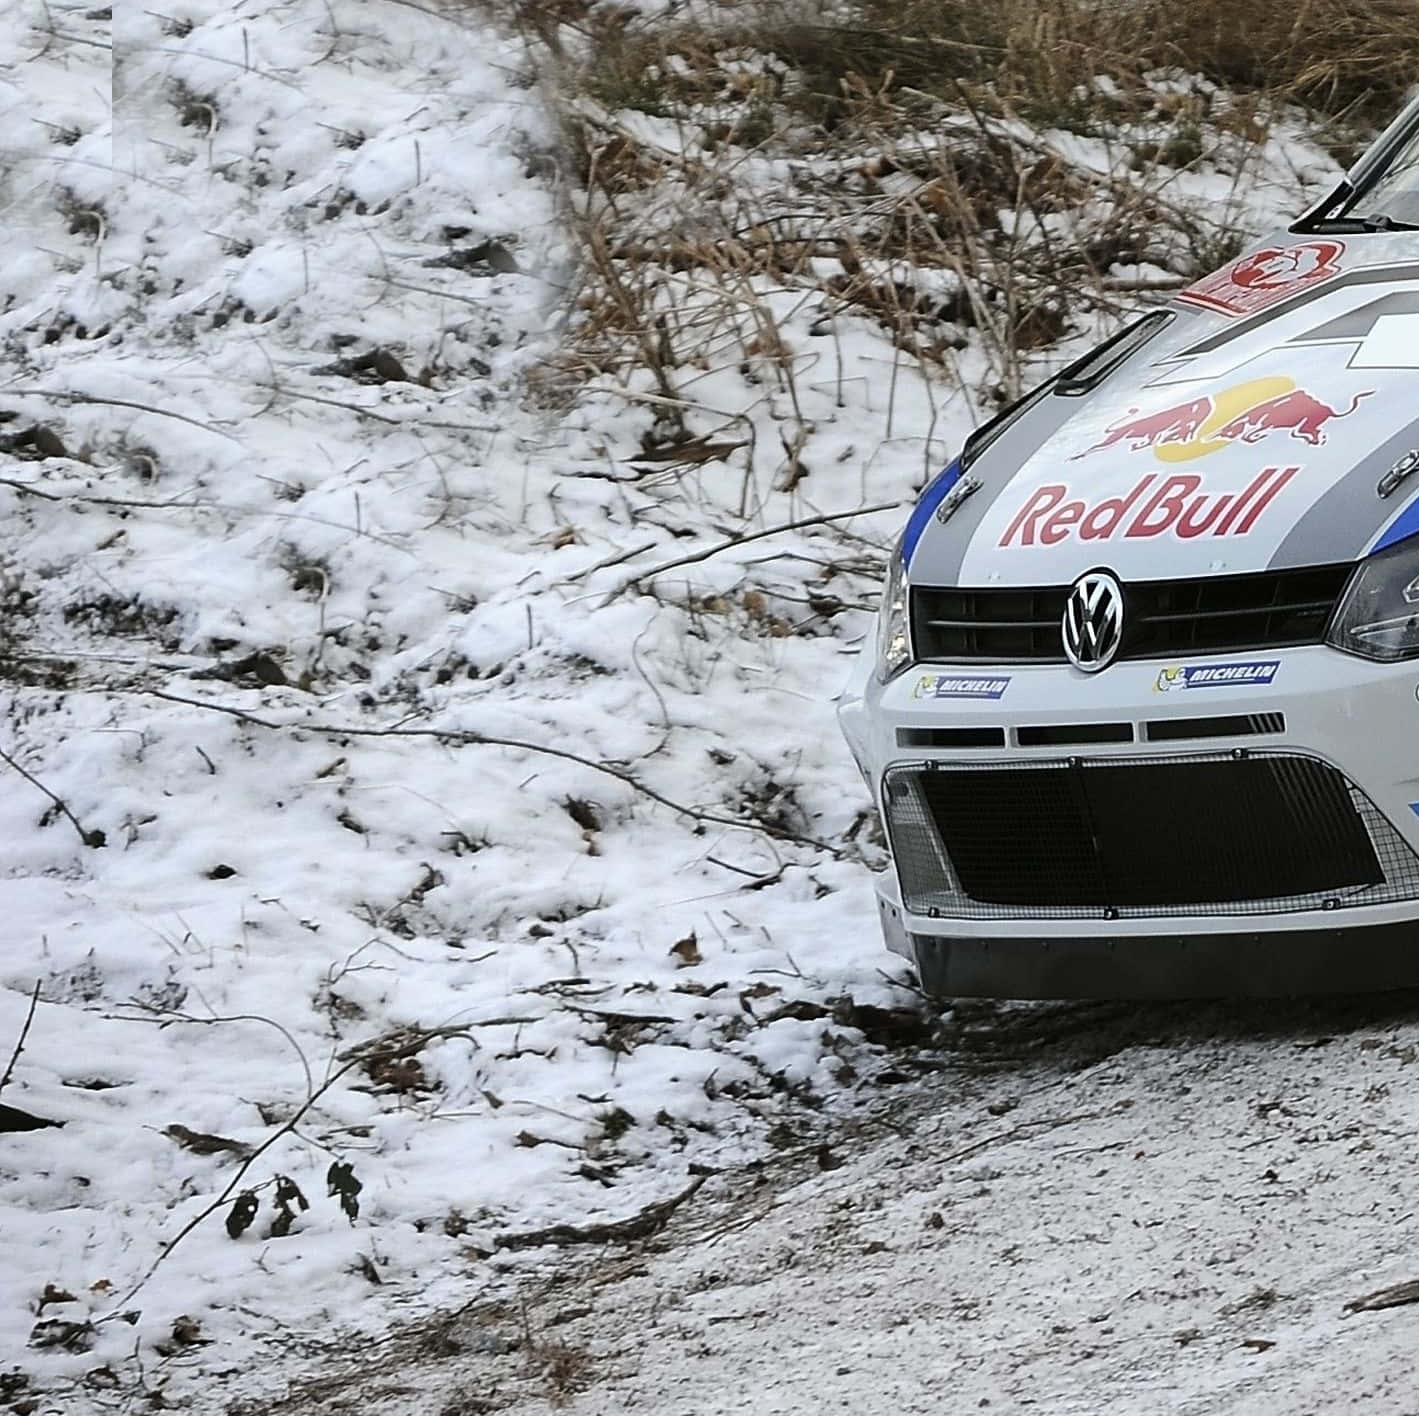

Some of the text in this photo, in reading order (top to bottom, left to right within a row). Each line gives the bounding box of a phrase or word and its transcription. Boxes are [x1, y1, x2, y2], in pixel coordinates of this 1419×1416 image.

[998, 467, 1300, 547] Red Bull
[1189, 664, 1277, 682] MICHELIN
[939, 679, 1008, 693] MICHELIN
